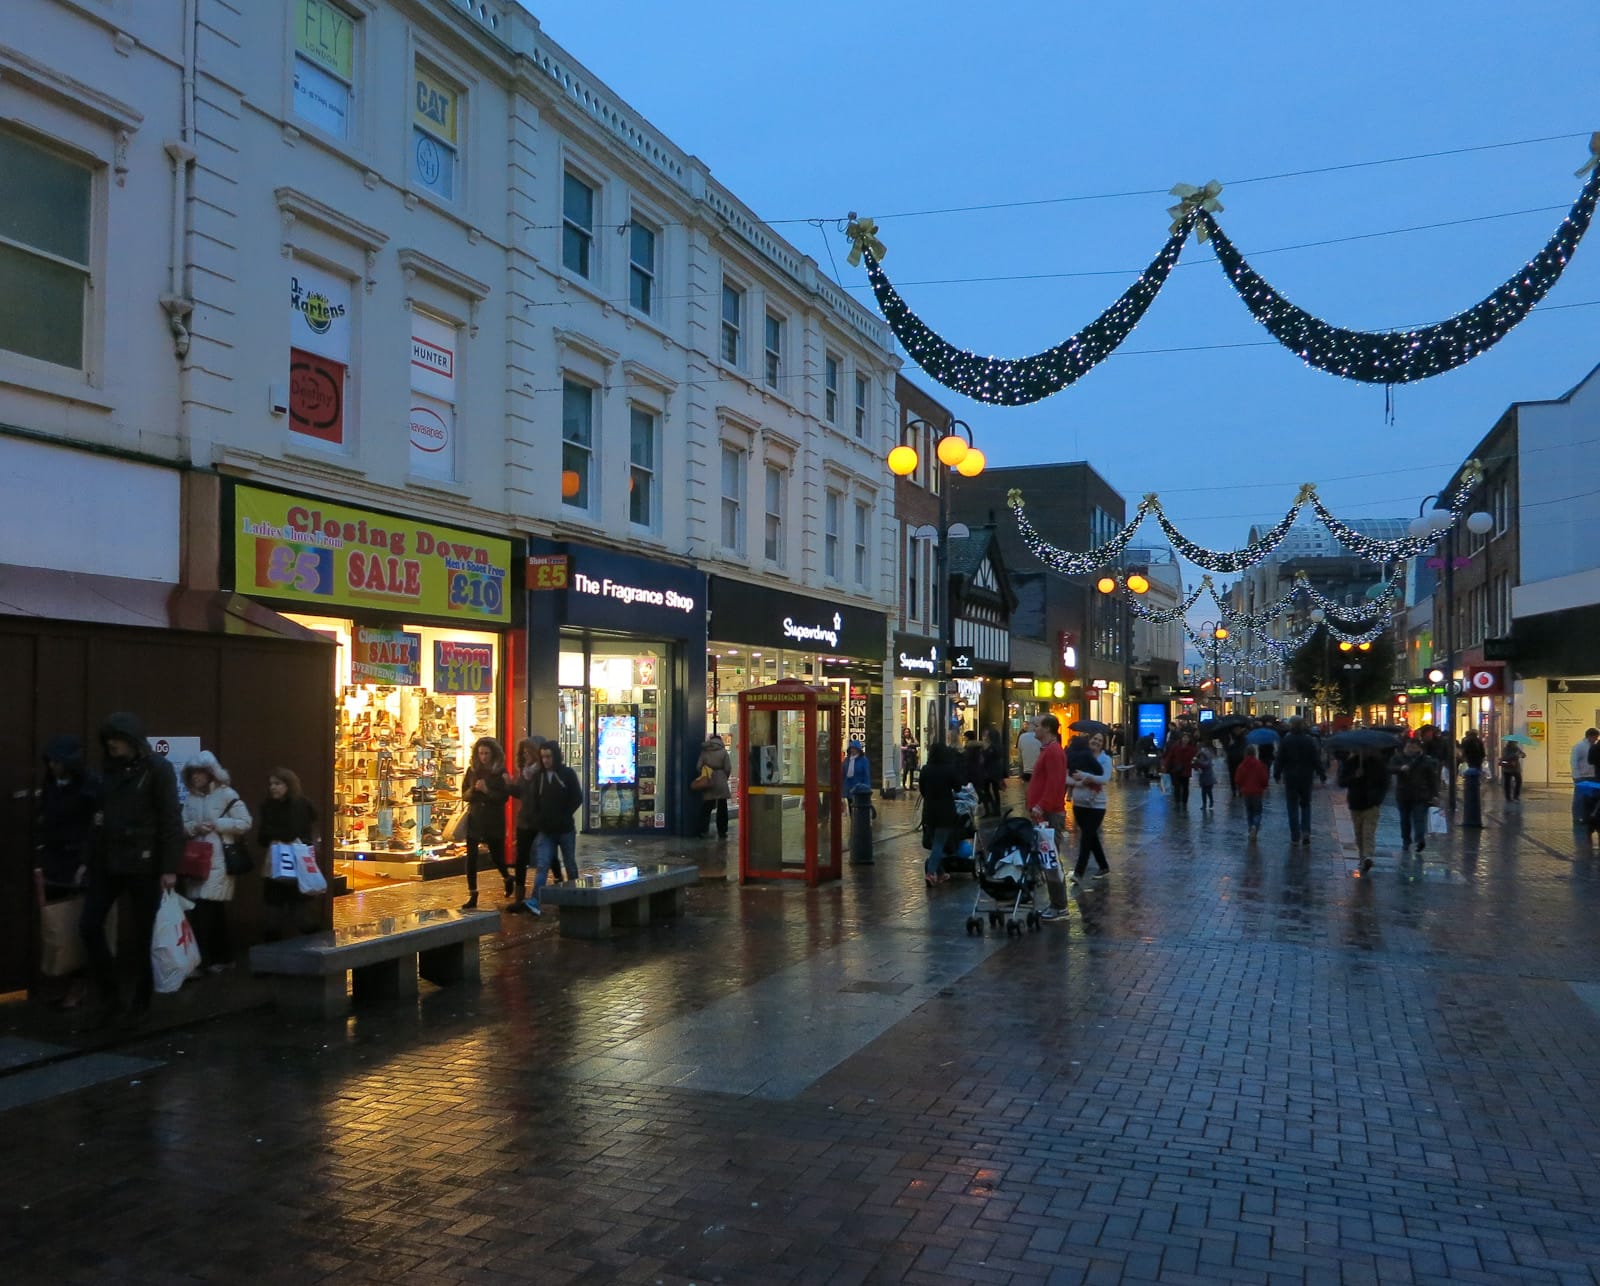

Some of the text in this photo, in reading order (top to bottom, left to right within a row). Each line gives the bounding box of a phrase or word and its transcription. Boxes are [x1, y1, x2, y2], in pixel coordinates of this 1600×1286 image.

[306, 0, 343, 55] FLY
[417, 80, 449, 127] CAT
[291, 293, 346, 319] Martens
[413, 345, 448, 368] HUNTER
[243, 517, 345, 549] Ladies Shoes From
[287, 506, 490, 566] Closing Down
[267, 545, 321, 594] £5
[347, 550, 422, 598] SALE
[537, 565, 567, 588] £5
[450, 573, 501, 611] £10
[574, 573, 695, 614] The Fragrance Shop
[783, 617, 839, 648] Superdrug
[368, 640, 411, 667] SALE
[440, 640, 490, 669] From
[900, 652, 936, 675] Superdrug
[447, 658, 483, 691] £10
[751, 692, 804, 702] TELEPHONE
[156, 744, 169, 753] DG
